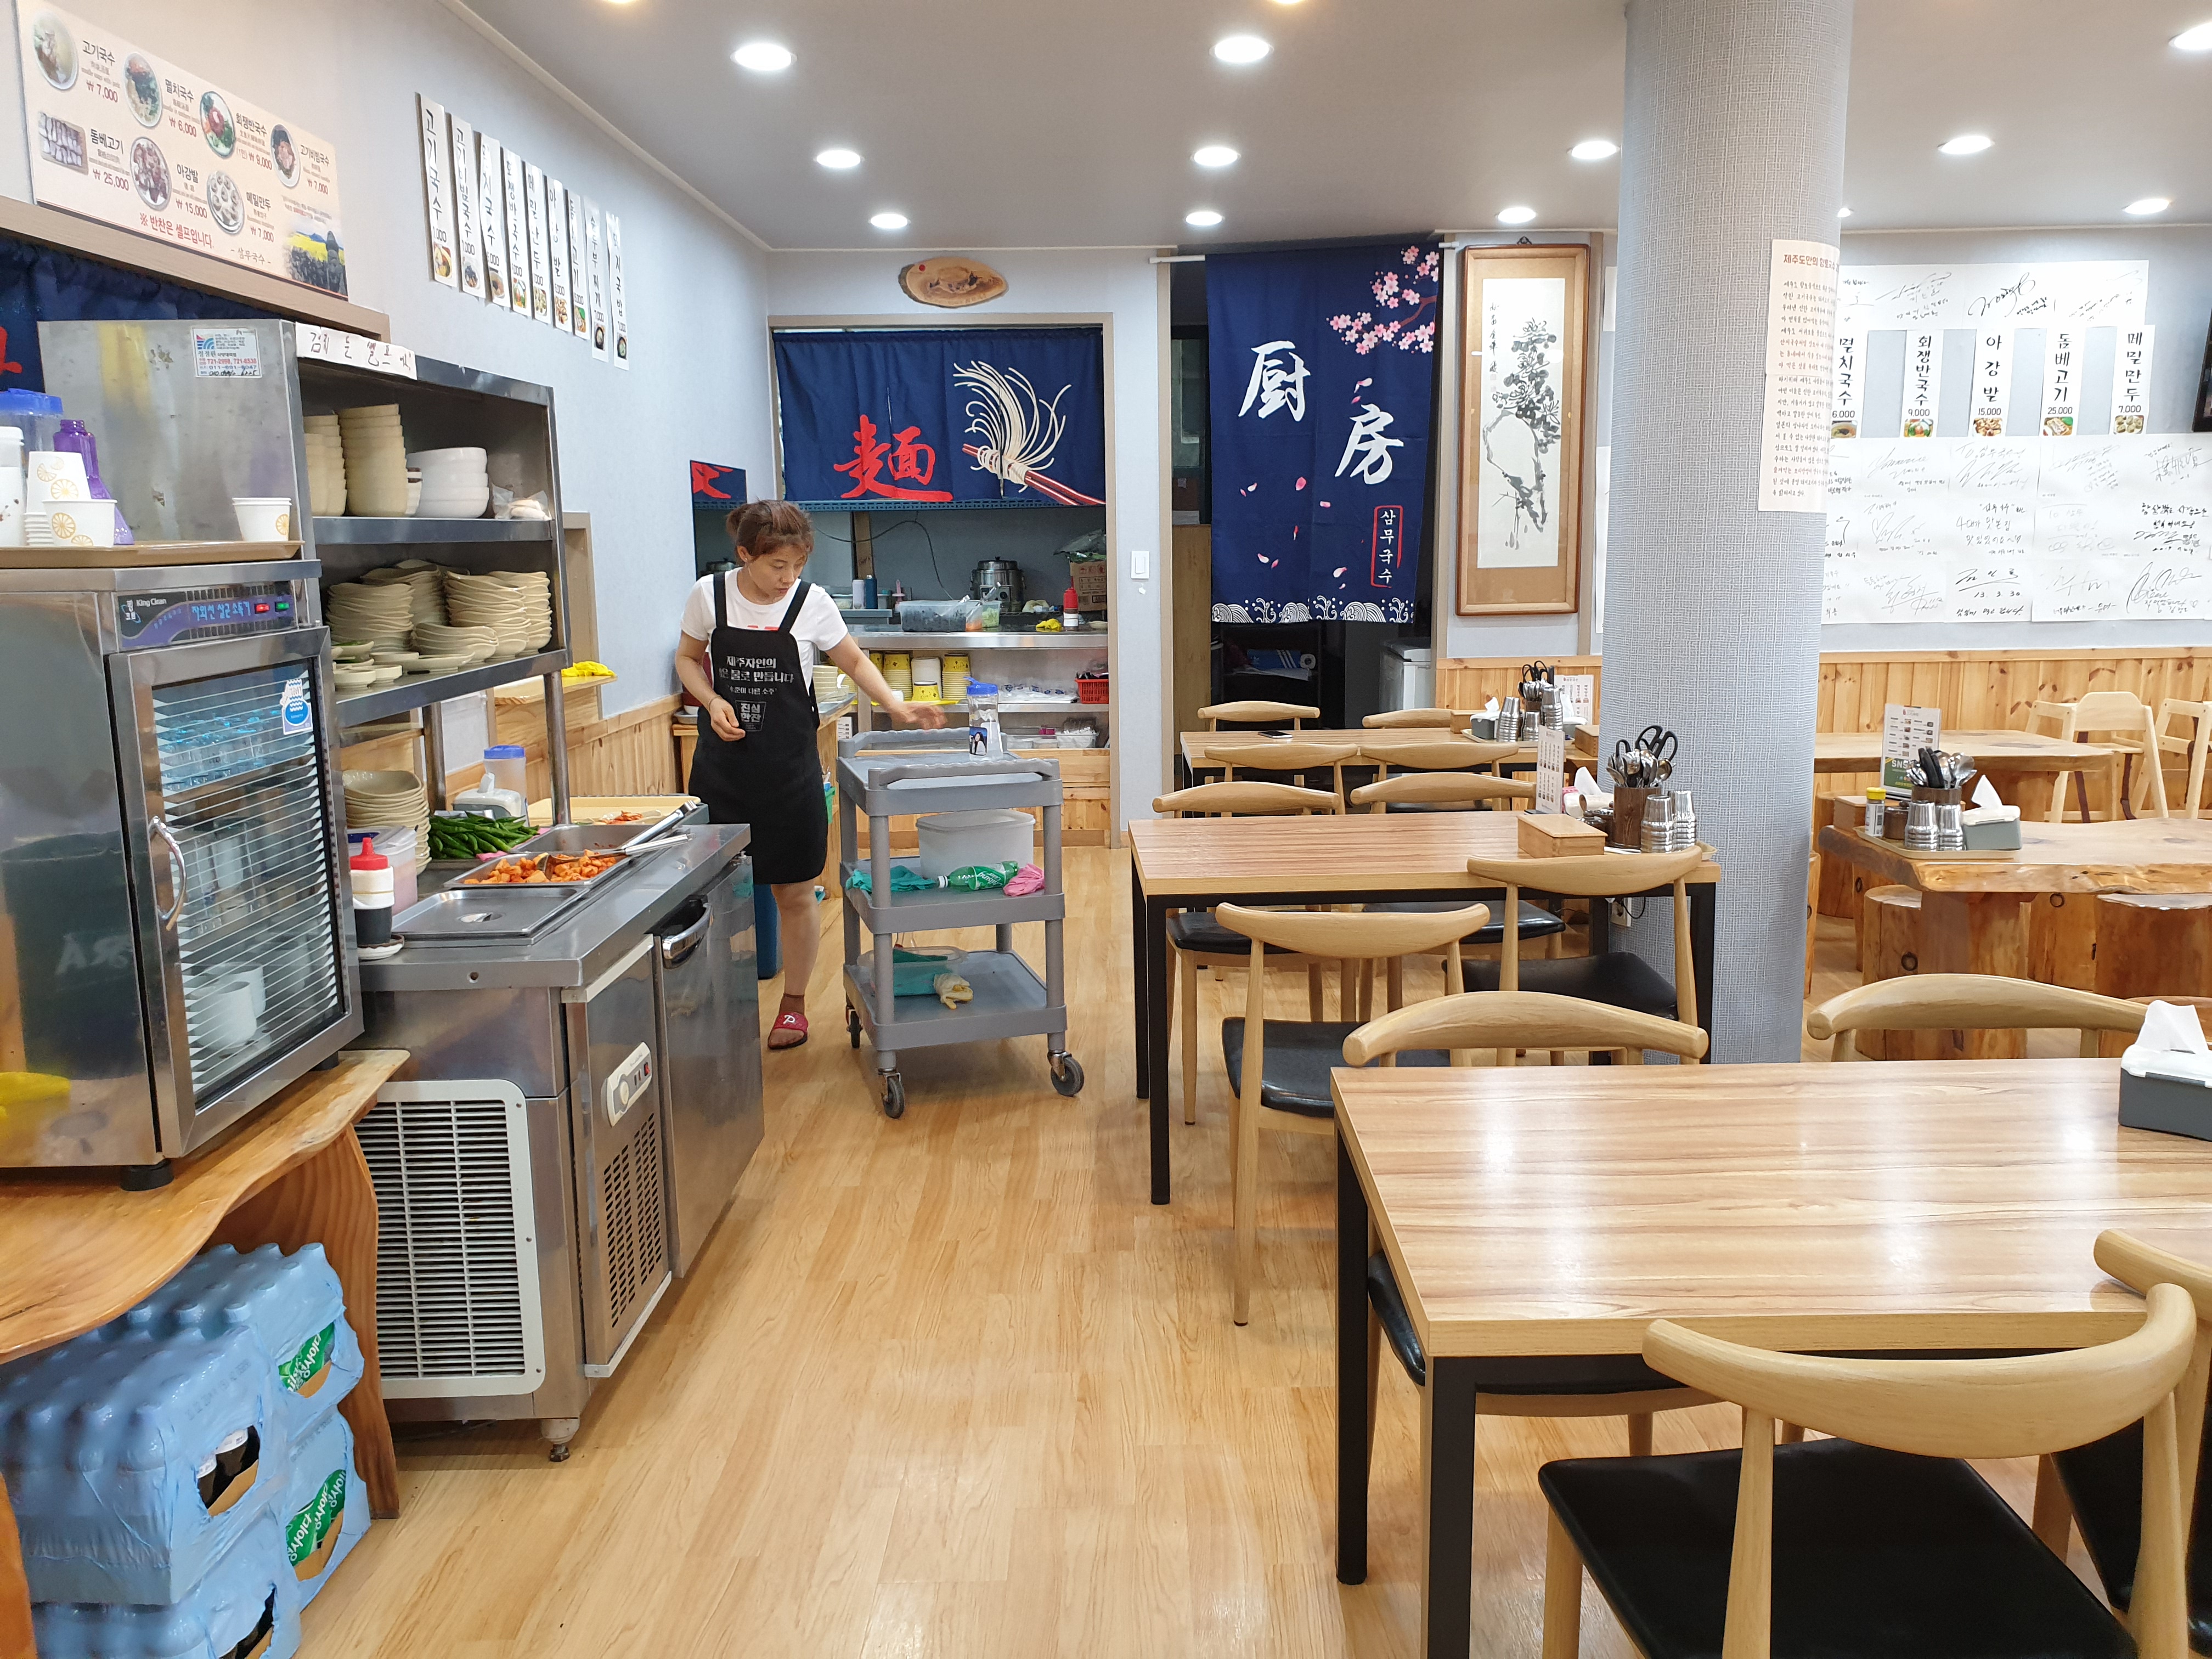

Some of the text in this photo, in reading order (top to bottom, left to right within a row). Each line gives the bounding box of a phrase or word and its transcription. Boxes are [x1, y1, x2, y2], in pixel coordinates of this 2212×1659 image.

[82, 40, 115, 66] 고기국수
[165, 78, 194, 103] 멸치국수
[91, 128, 124, 154] 돔베고기
[426, 109, 442, 221] 고기국수
[246, 191, 271, 211] 메밀만두
[482, 144, 495, 246] 치국수
[150, 215, 173, 236] 반찬은
[1783, 254, 1818, 267] 제주도만의
[311, 332, 330, 354] 김치
[1837, 337, 1854, 406] 멸치국수
[1914, 335, 1932, 407] 회쟁반국수
[1983, 335, 2002, 402] 아강발
[2054, 333, 2070, 402] 돔베고기
[2124, 331, 2143, 402] 메밀만두
[833, 414, 953, 502] 麵
[1378, 509, 1396, 585] 삼무국수
[136, 597, 167, 607] King Clean
[731, 669, 751, 681] 물로
[753, 672, 794, 683] 만듭니다
[741, 703, 761, 713] 진심
[741, 713, 761, 723] 한잔
